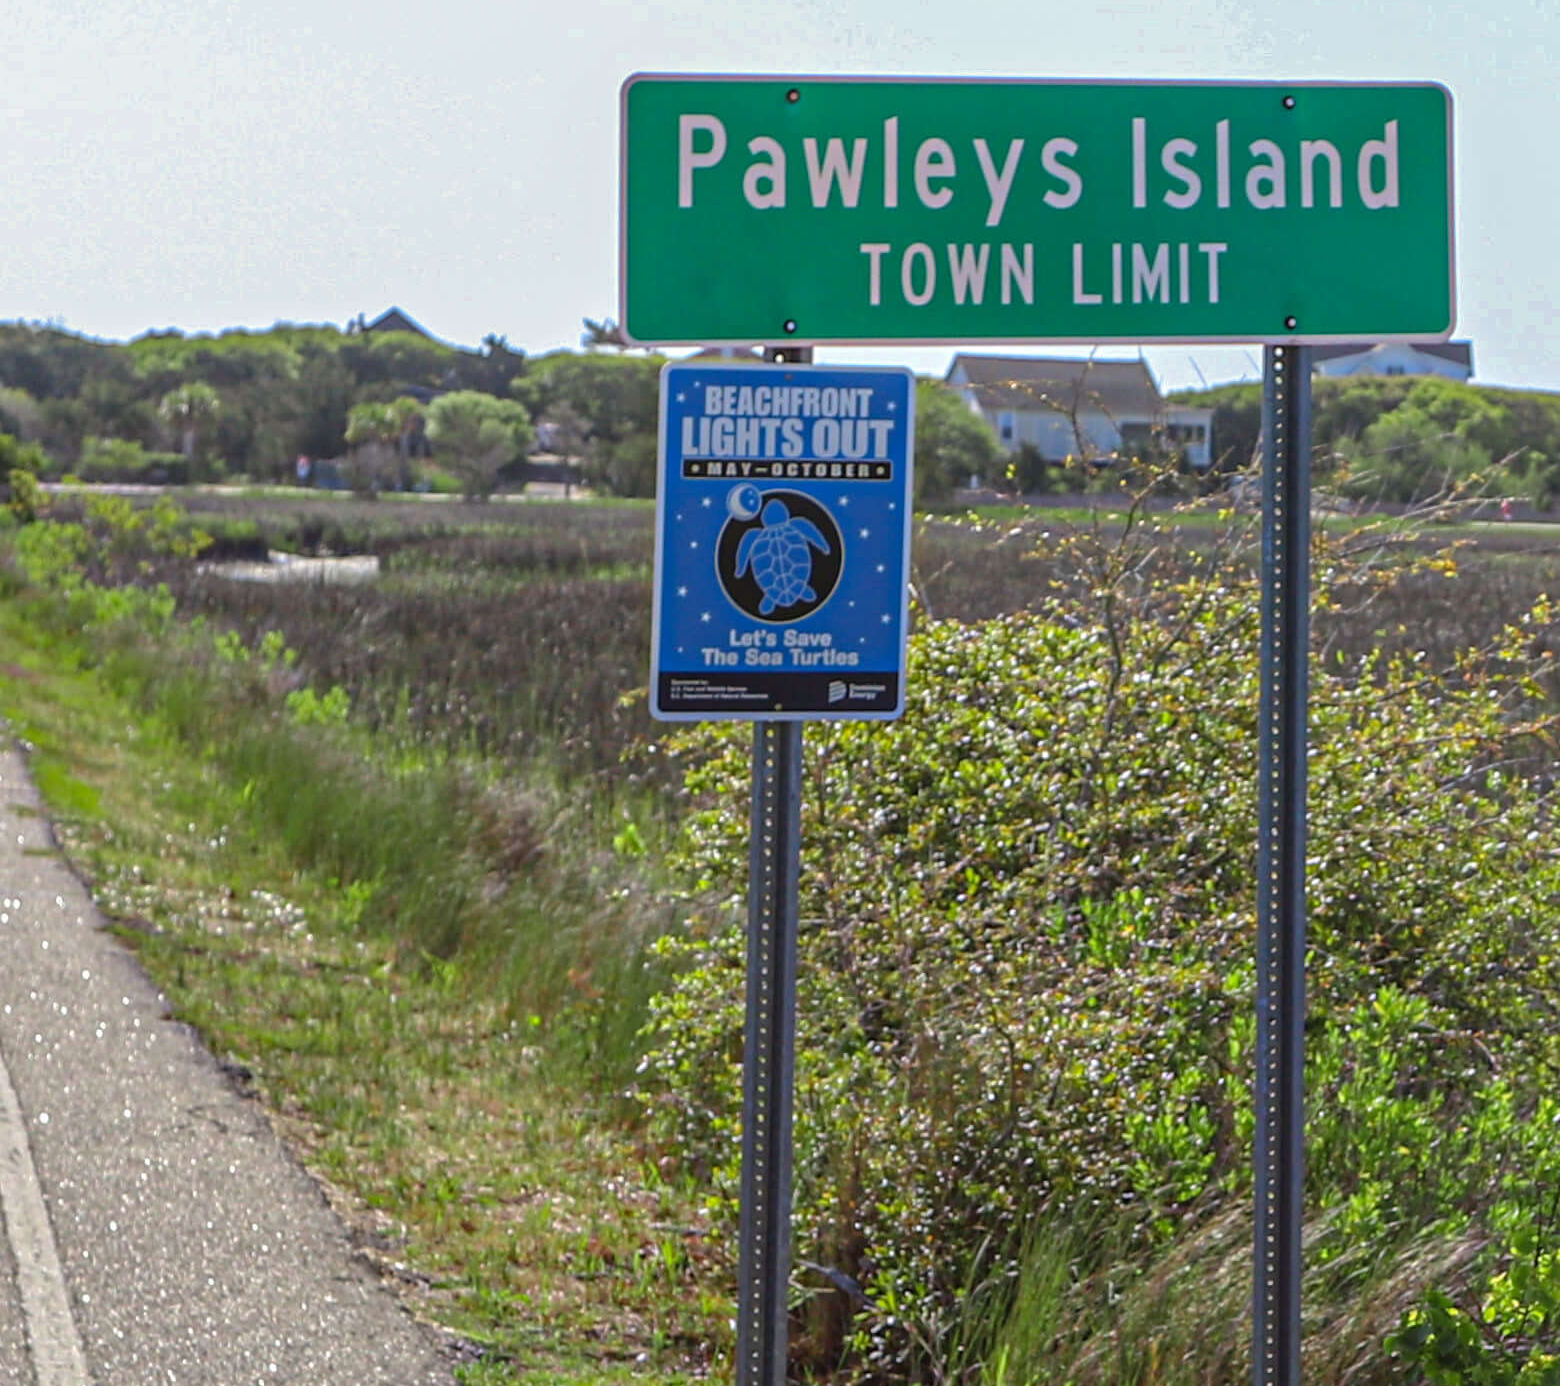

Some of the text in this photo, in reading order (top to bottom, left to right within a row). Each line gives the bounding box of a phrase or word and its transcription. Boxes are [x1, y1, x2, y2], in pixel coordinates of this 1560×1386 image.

[677, 113, 1401, 227] Pawleys Island
[860, 242, 1229, 306] TOWN LIMIT
[704, 385, 874, 418] BEACHFRONT
[681, 416, 895, 459] LIGHTS OUT
[701, 647, 860, 667] The Sea Turtles
[728, 629, 832, 648] Let's Save
